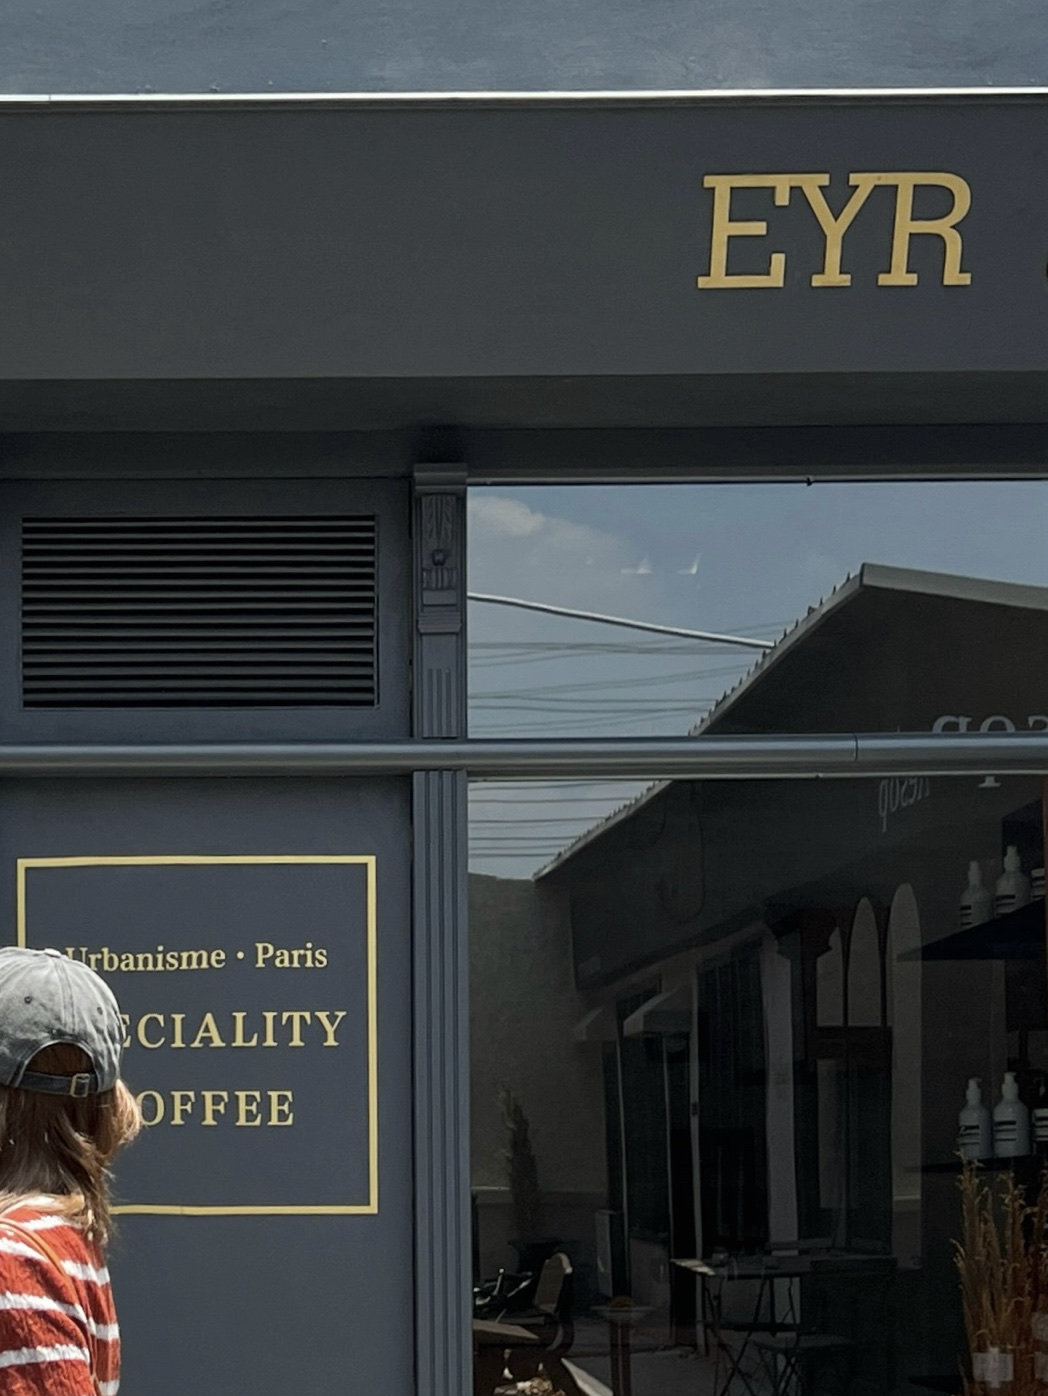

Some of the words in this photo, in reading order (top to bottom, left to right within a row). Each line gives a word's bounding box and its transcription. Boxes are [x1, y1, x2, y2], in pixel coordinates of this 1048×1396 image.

[697, 171, 972, 288] EYR
[254, 941, 328, 969] Paris
[135, 1089, 295, 1128] OFFEE
